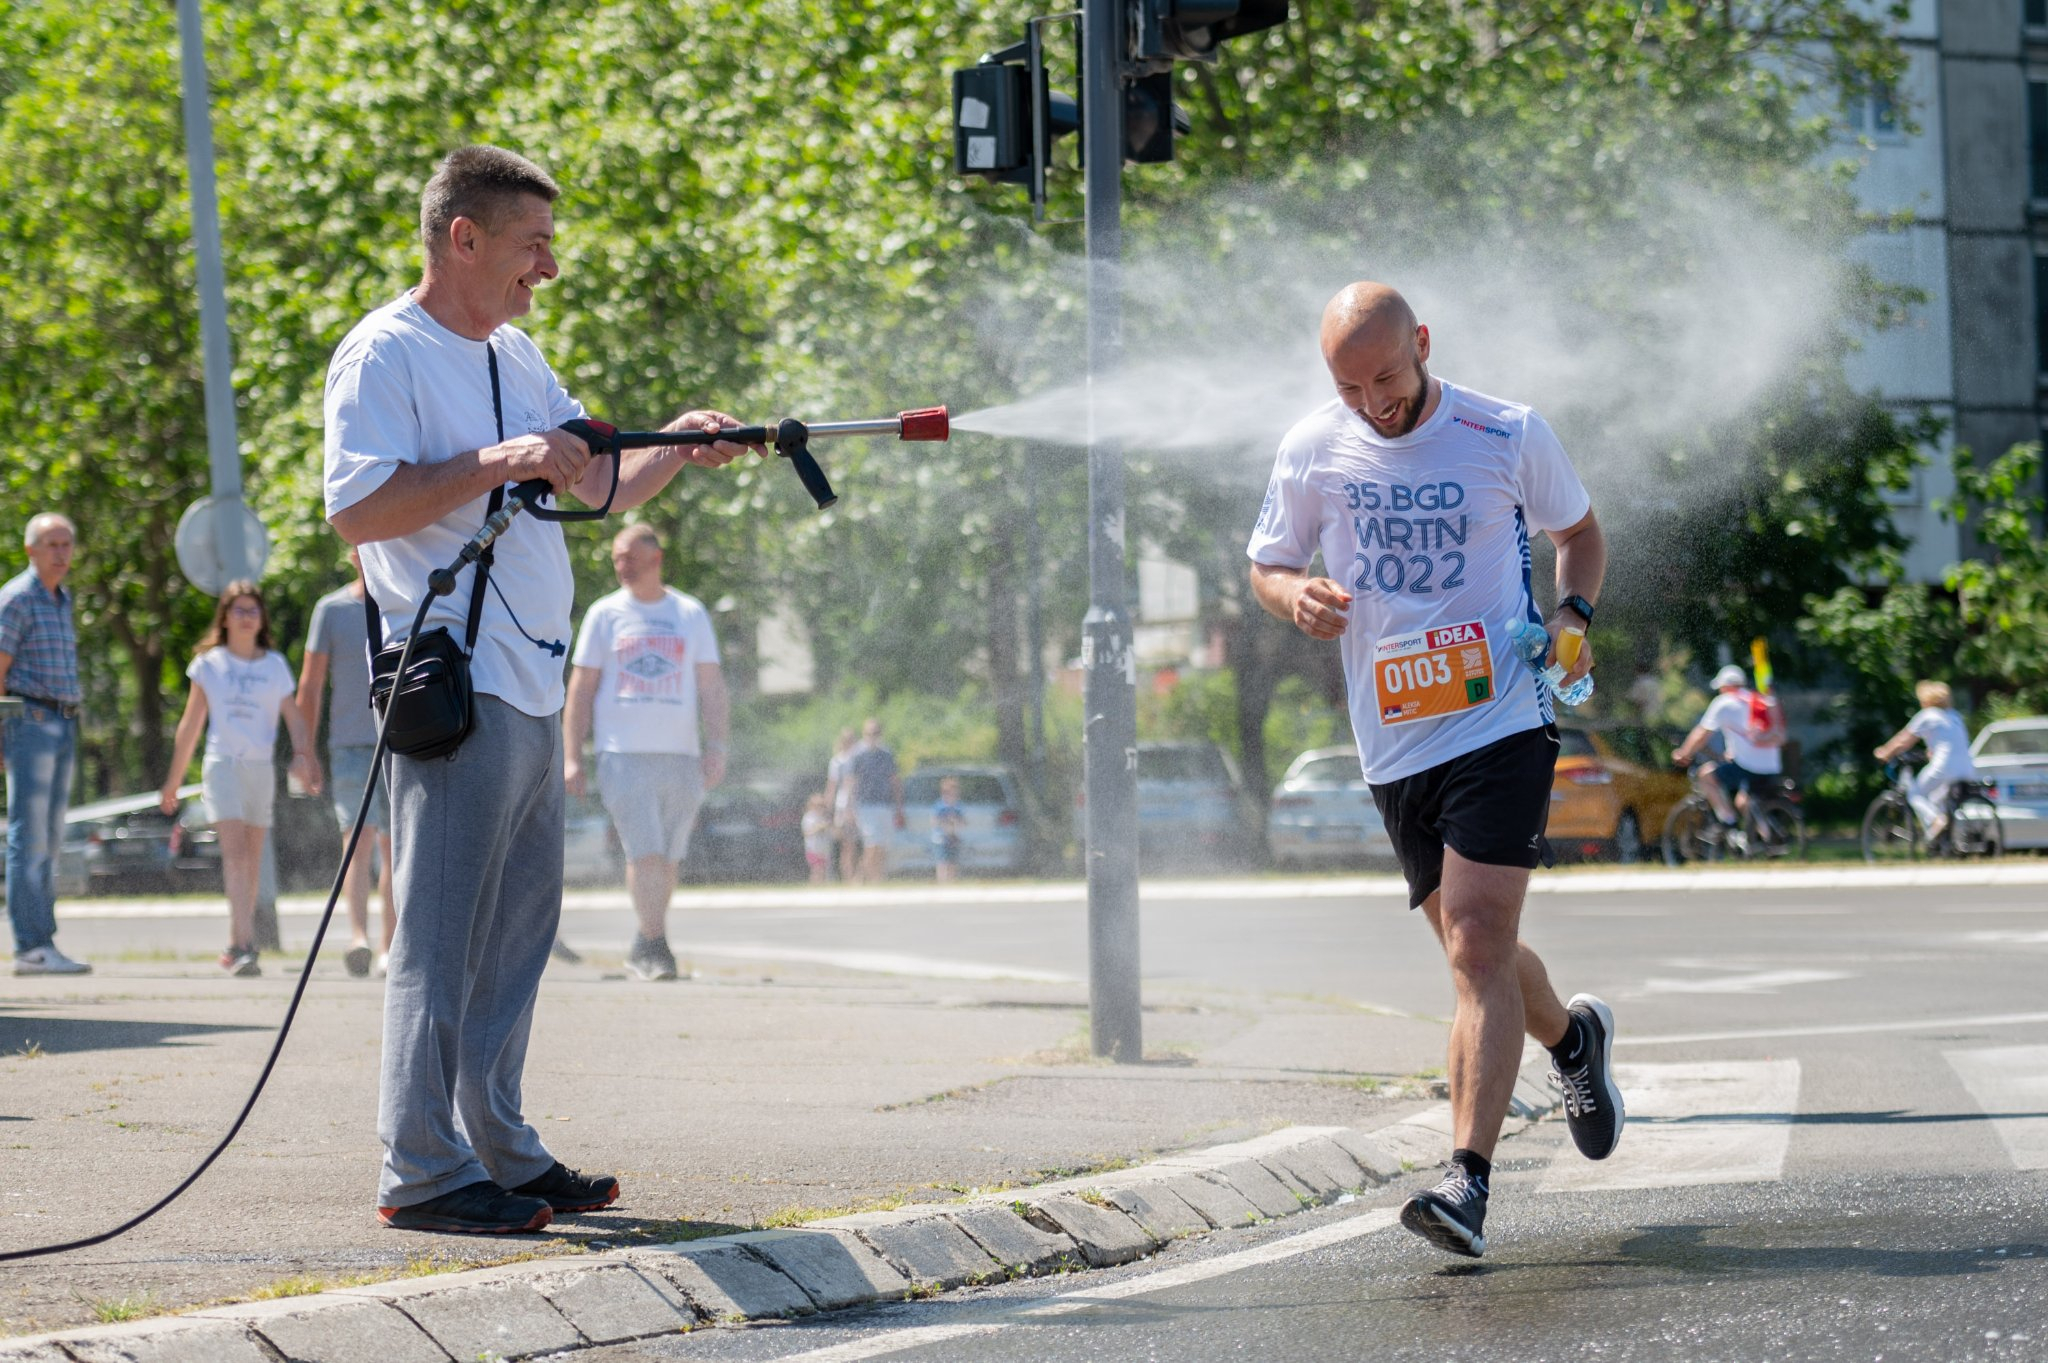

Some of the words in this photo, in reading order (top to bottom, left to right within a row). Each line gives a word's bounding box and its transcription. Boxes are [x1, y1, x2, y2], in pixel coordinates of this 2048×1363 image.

[1460, 419, 1511, 439] INTERSPORT
[1354, 551, 1465, 594] 2022
[1381, 638, 1422, 651] INTERSPORT
[1384, 653, 1452, 694] 0103
[1474, 682, 1484, 698] D
[1402, 701, 1420, 709] ALEKSA
